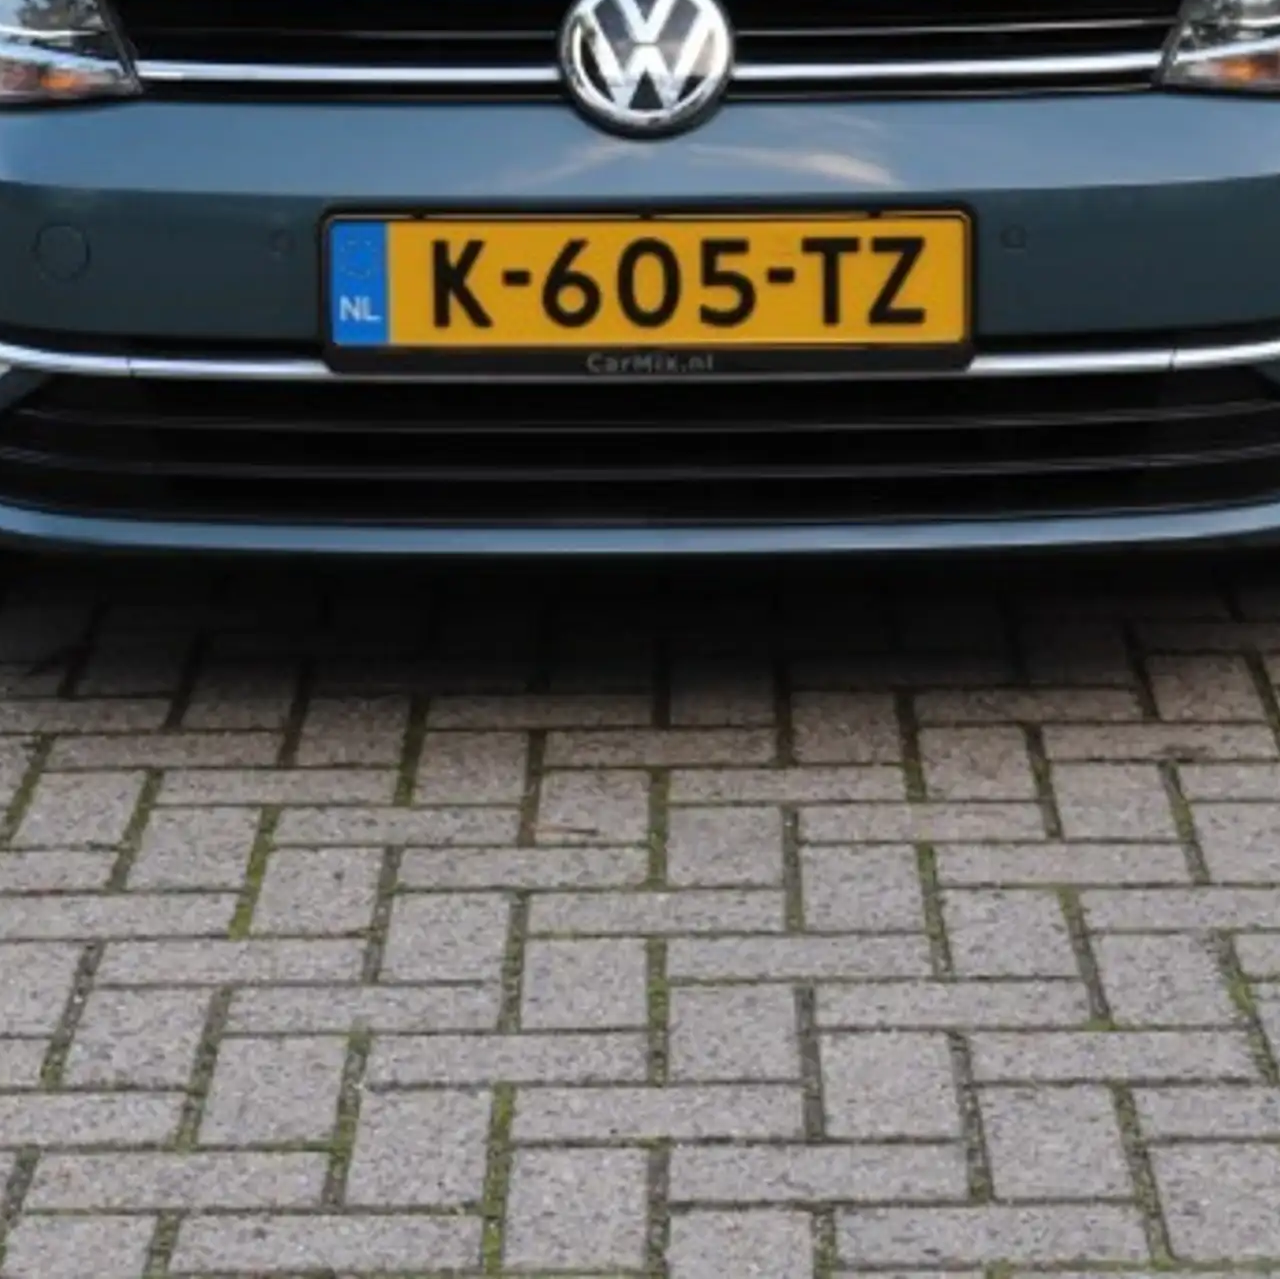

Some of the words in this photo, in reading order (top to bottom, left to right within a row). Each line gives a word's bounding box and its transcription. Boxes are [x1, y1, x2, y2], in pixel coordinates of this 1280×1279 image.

[431, 236, 927, 329] K-605-TZ
[338, 295, 381, 322] NL
[586, 353, 716, 374] CarMix.nl
